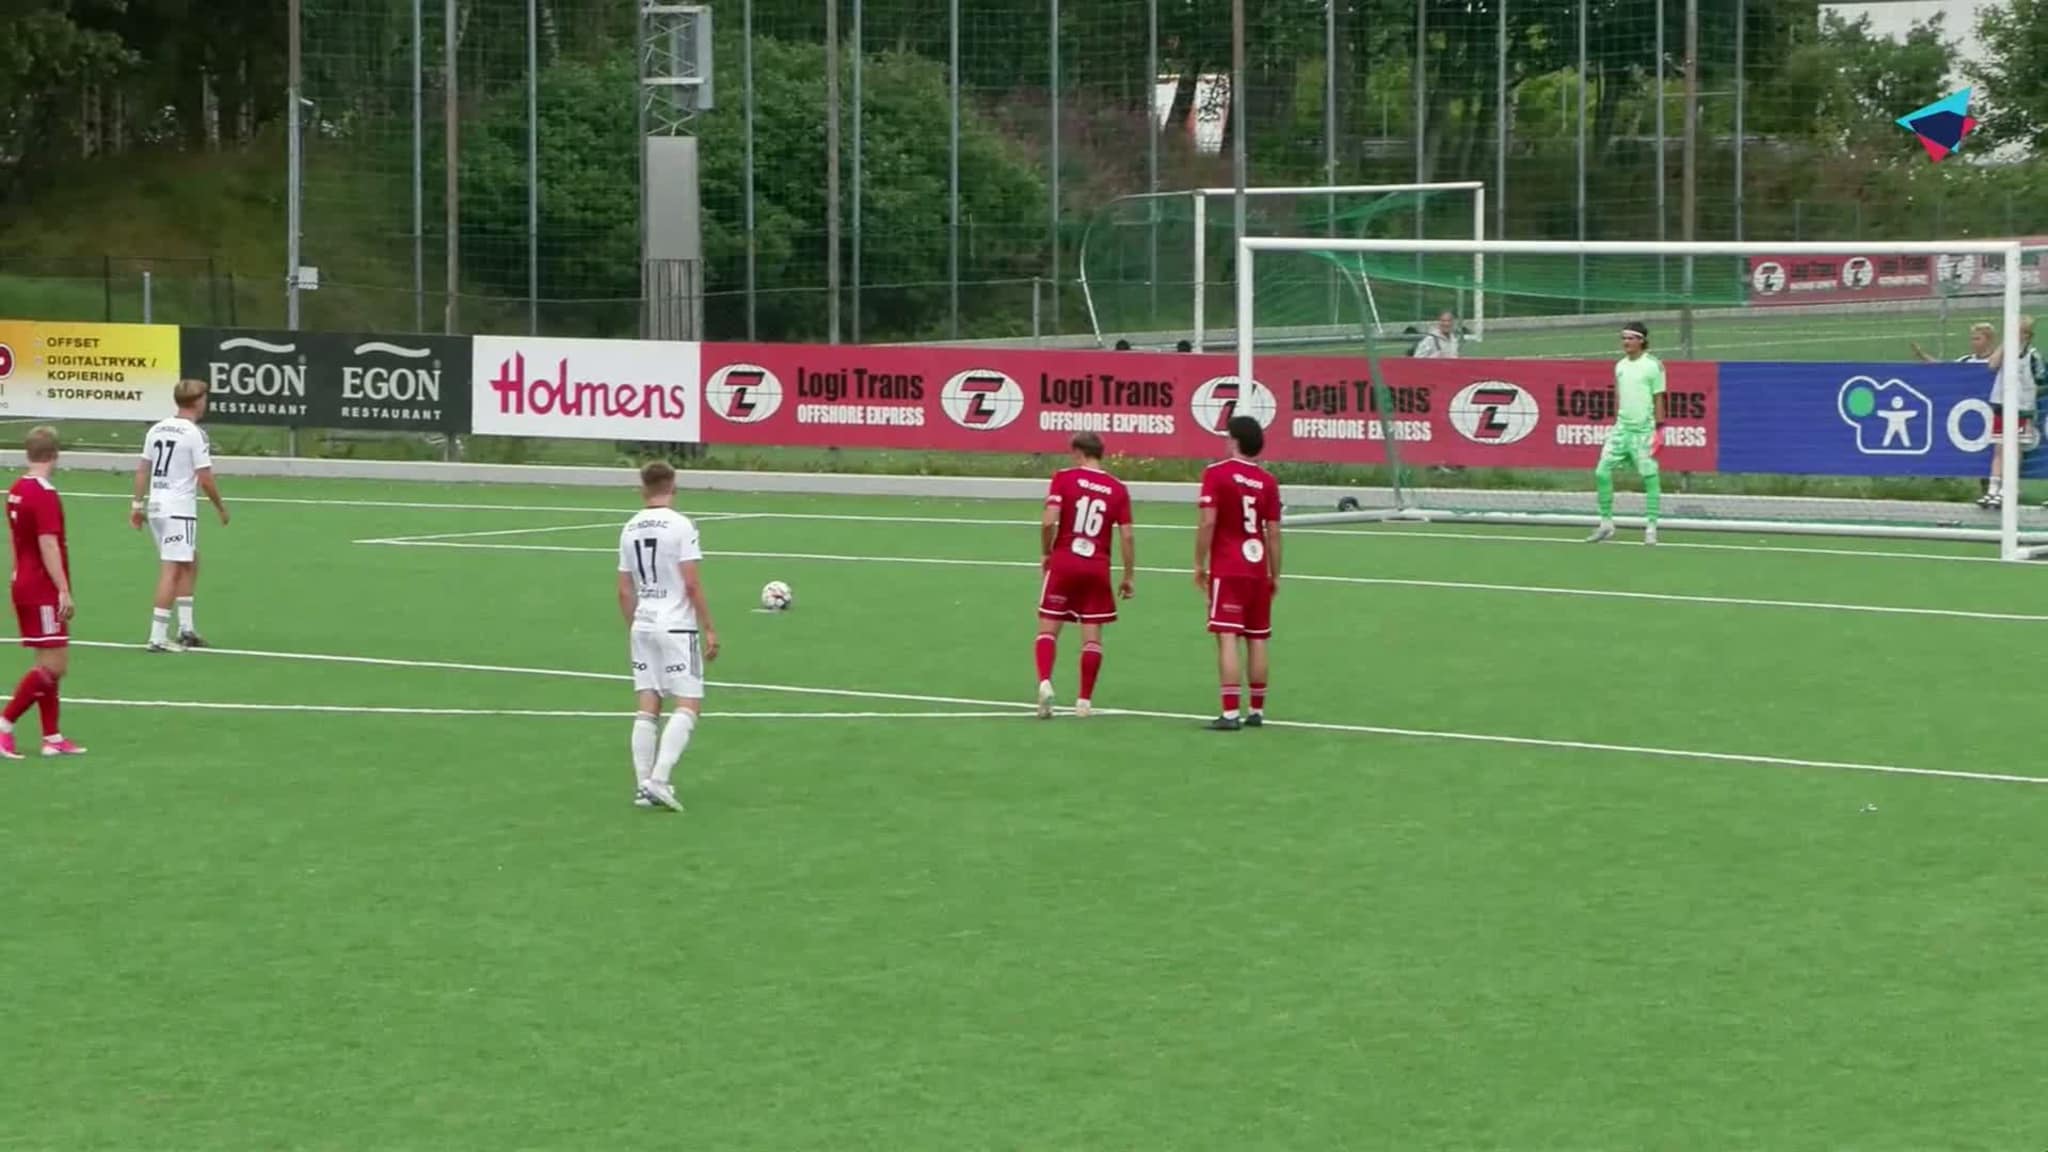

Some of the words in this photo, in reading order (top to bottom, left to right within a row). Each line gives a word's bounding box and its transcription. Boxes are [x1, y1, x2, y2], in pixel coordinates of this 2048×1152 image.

[47, 337, 100, 348] OFFSET
[47, 355, 146, 368] DIGITALTRYKK
[47, 371, 125, 382] KOPIERING
[47, 388, 143, 401] STORFORMAT
[209, 362, 307, 397] EGON
[342, 366, 441, 402] EGON
[489, 350, 685, 420] Holmens
[798, 367, 848, 401] Logi
[853, 368, 924, 401] Trans
[1040, 373, 1093, 409] Logi
[1100, 375, 1174, 408] Trans
[209, 402, 308, 416] RESTAURANT
[341, 406, 442, 421] RESTAURANT
[1292, 379, 1347, 415] Logi
[1556, 383, 1616, 421] Logi
[797, 404, 864, 424] OFFSHORE
[866, 405, 925, 426] EXPRESS
[1040, 411, 1111, 432] OFFSHORE
[1113, 413, 1175, 435] EXPRESS
[1293, 418, 1365, 440] OFFSHORE
[1367, 420, 1433, 441] EXRESS
[153, 440, 176, 477] 27
[1073, 496, 1107, 538] 16
[1242, 495, 1258, 534] 5
[634, 538, 658, 585] 17
